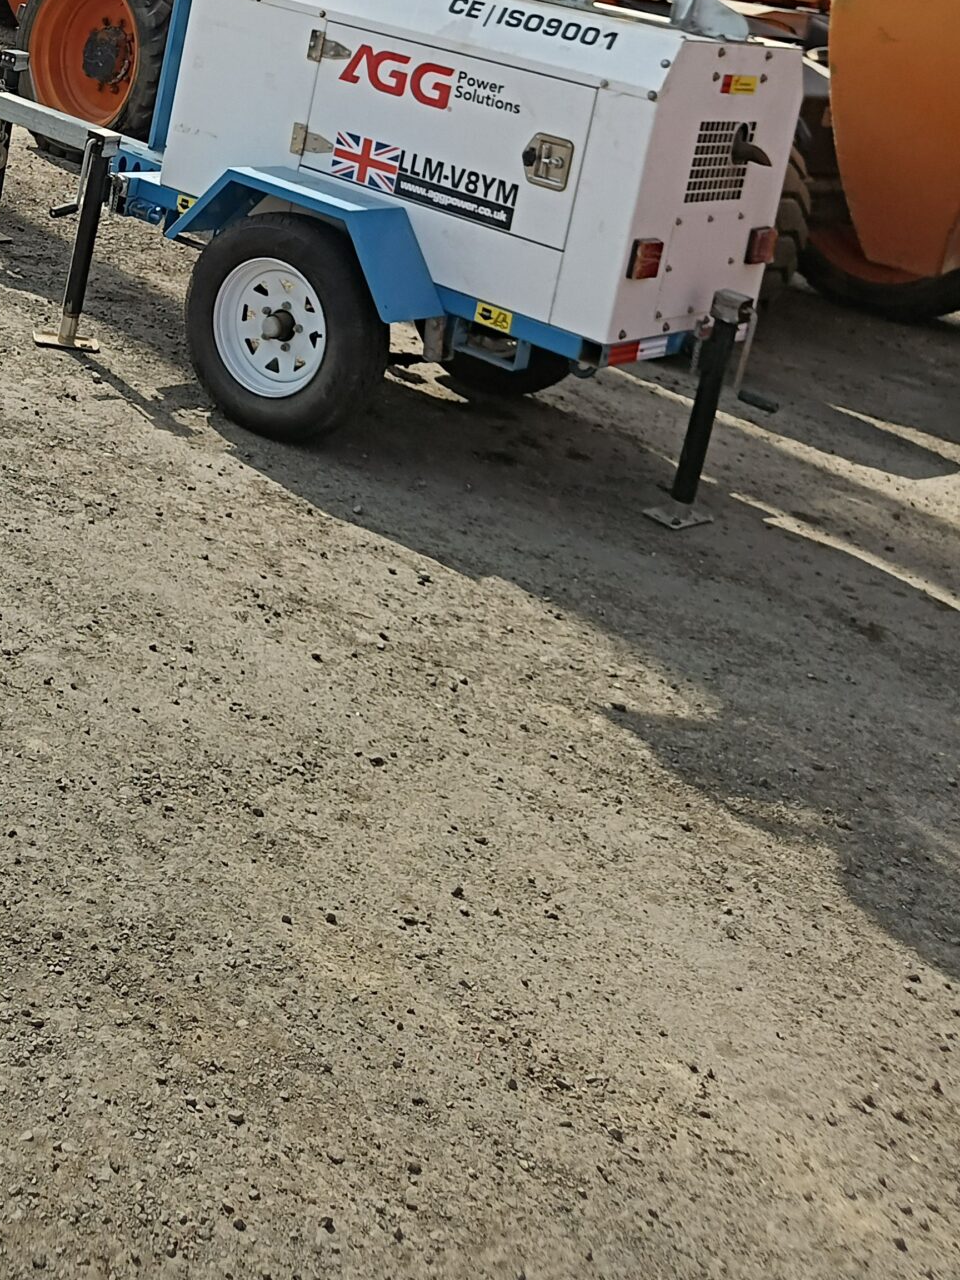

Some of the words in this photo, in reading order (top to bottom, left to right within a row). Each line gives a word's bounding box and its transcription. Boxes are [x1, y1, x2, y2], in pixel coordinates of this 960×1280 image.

[338, 44, 455, 110] AGG
[458, 71, 505, 95] Power
[454, 85, 521, 114] Solutions
[397, 150, 519, 207] LLM-V8YM
[400, 180, 507, 222] www.aggpower.co.uk
